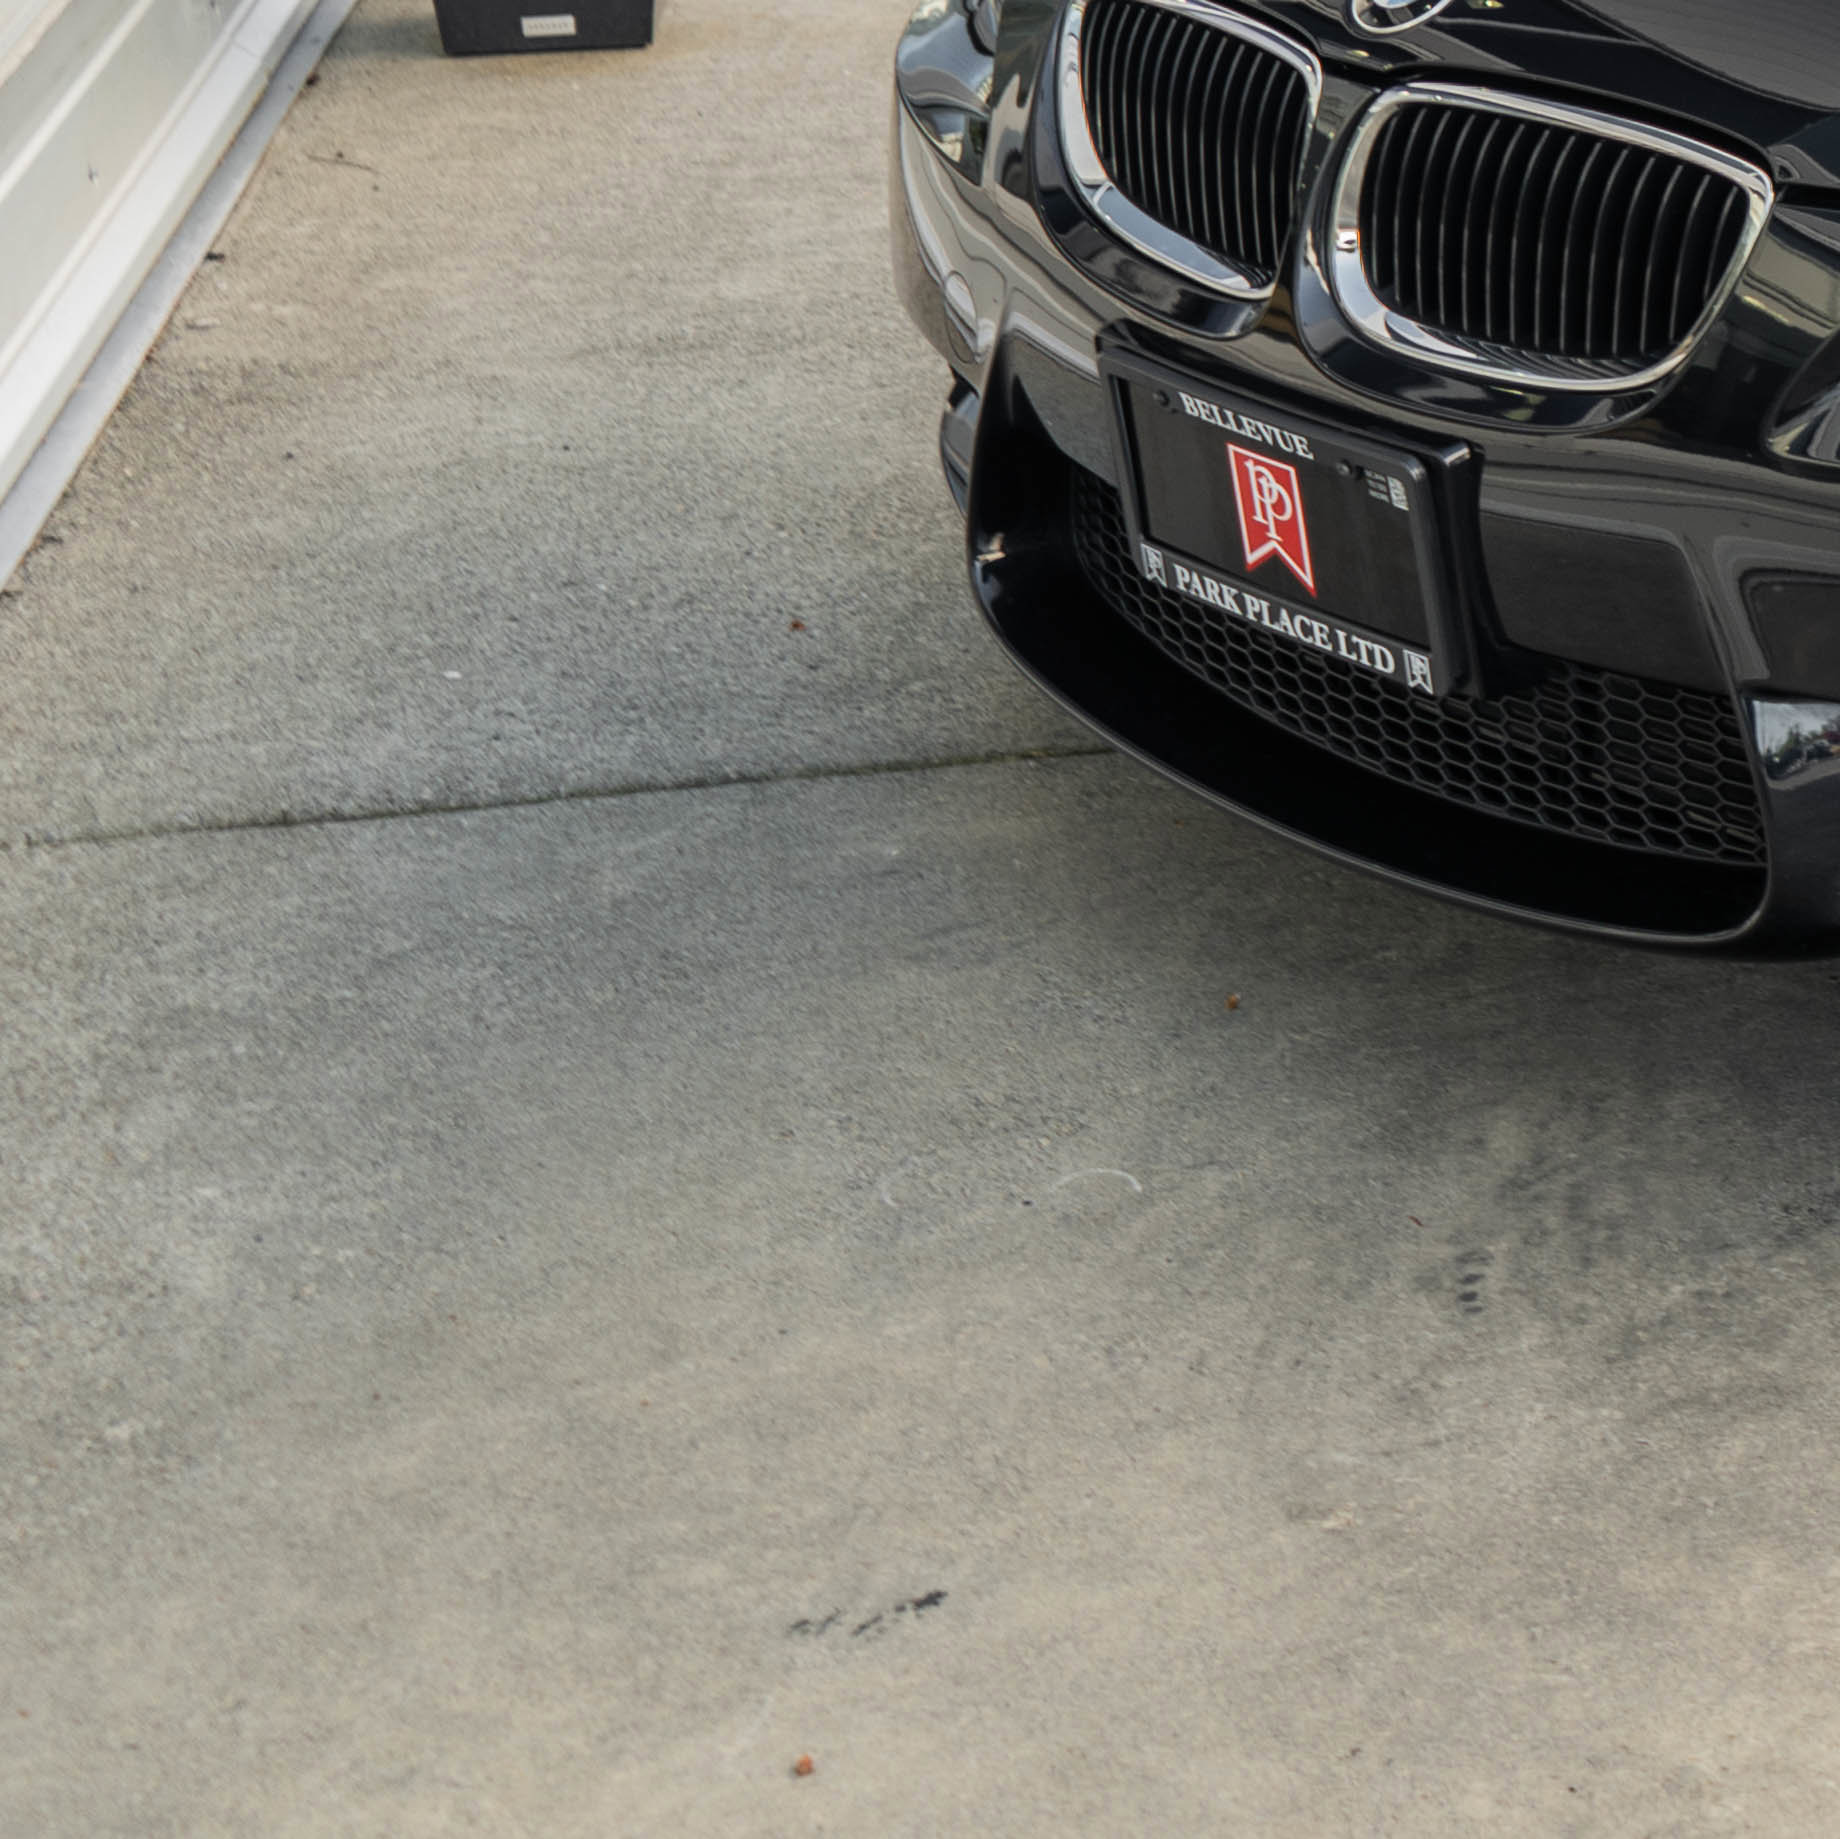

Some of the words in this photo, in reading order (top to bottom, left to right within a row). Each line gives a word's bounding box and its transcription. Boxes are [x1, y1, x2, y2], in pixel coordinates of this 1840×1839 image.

[1178, 391, 1315, 460] BELLEVUE
[1173, 563, 1243, 616] PARK
[1242, 592, 1333, 651] PLACE
[1336, 628, 1396, 674] LTD
